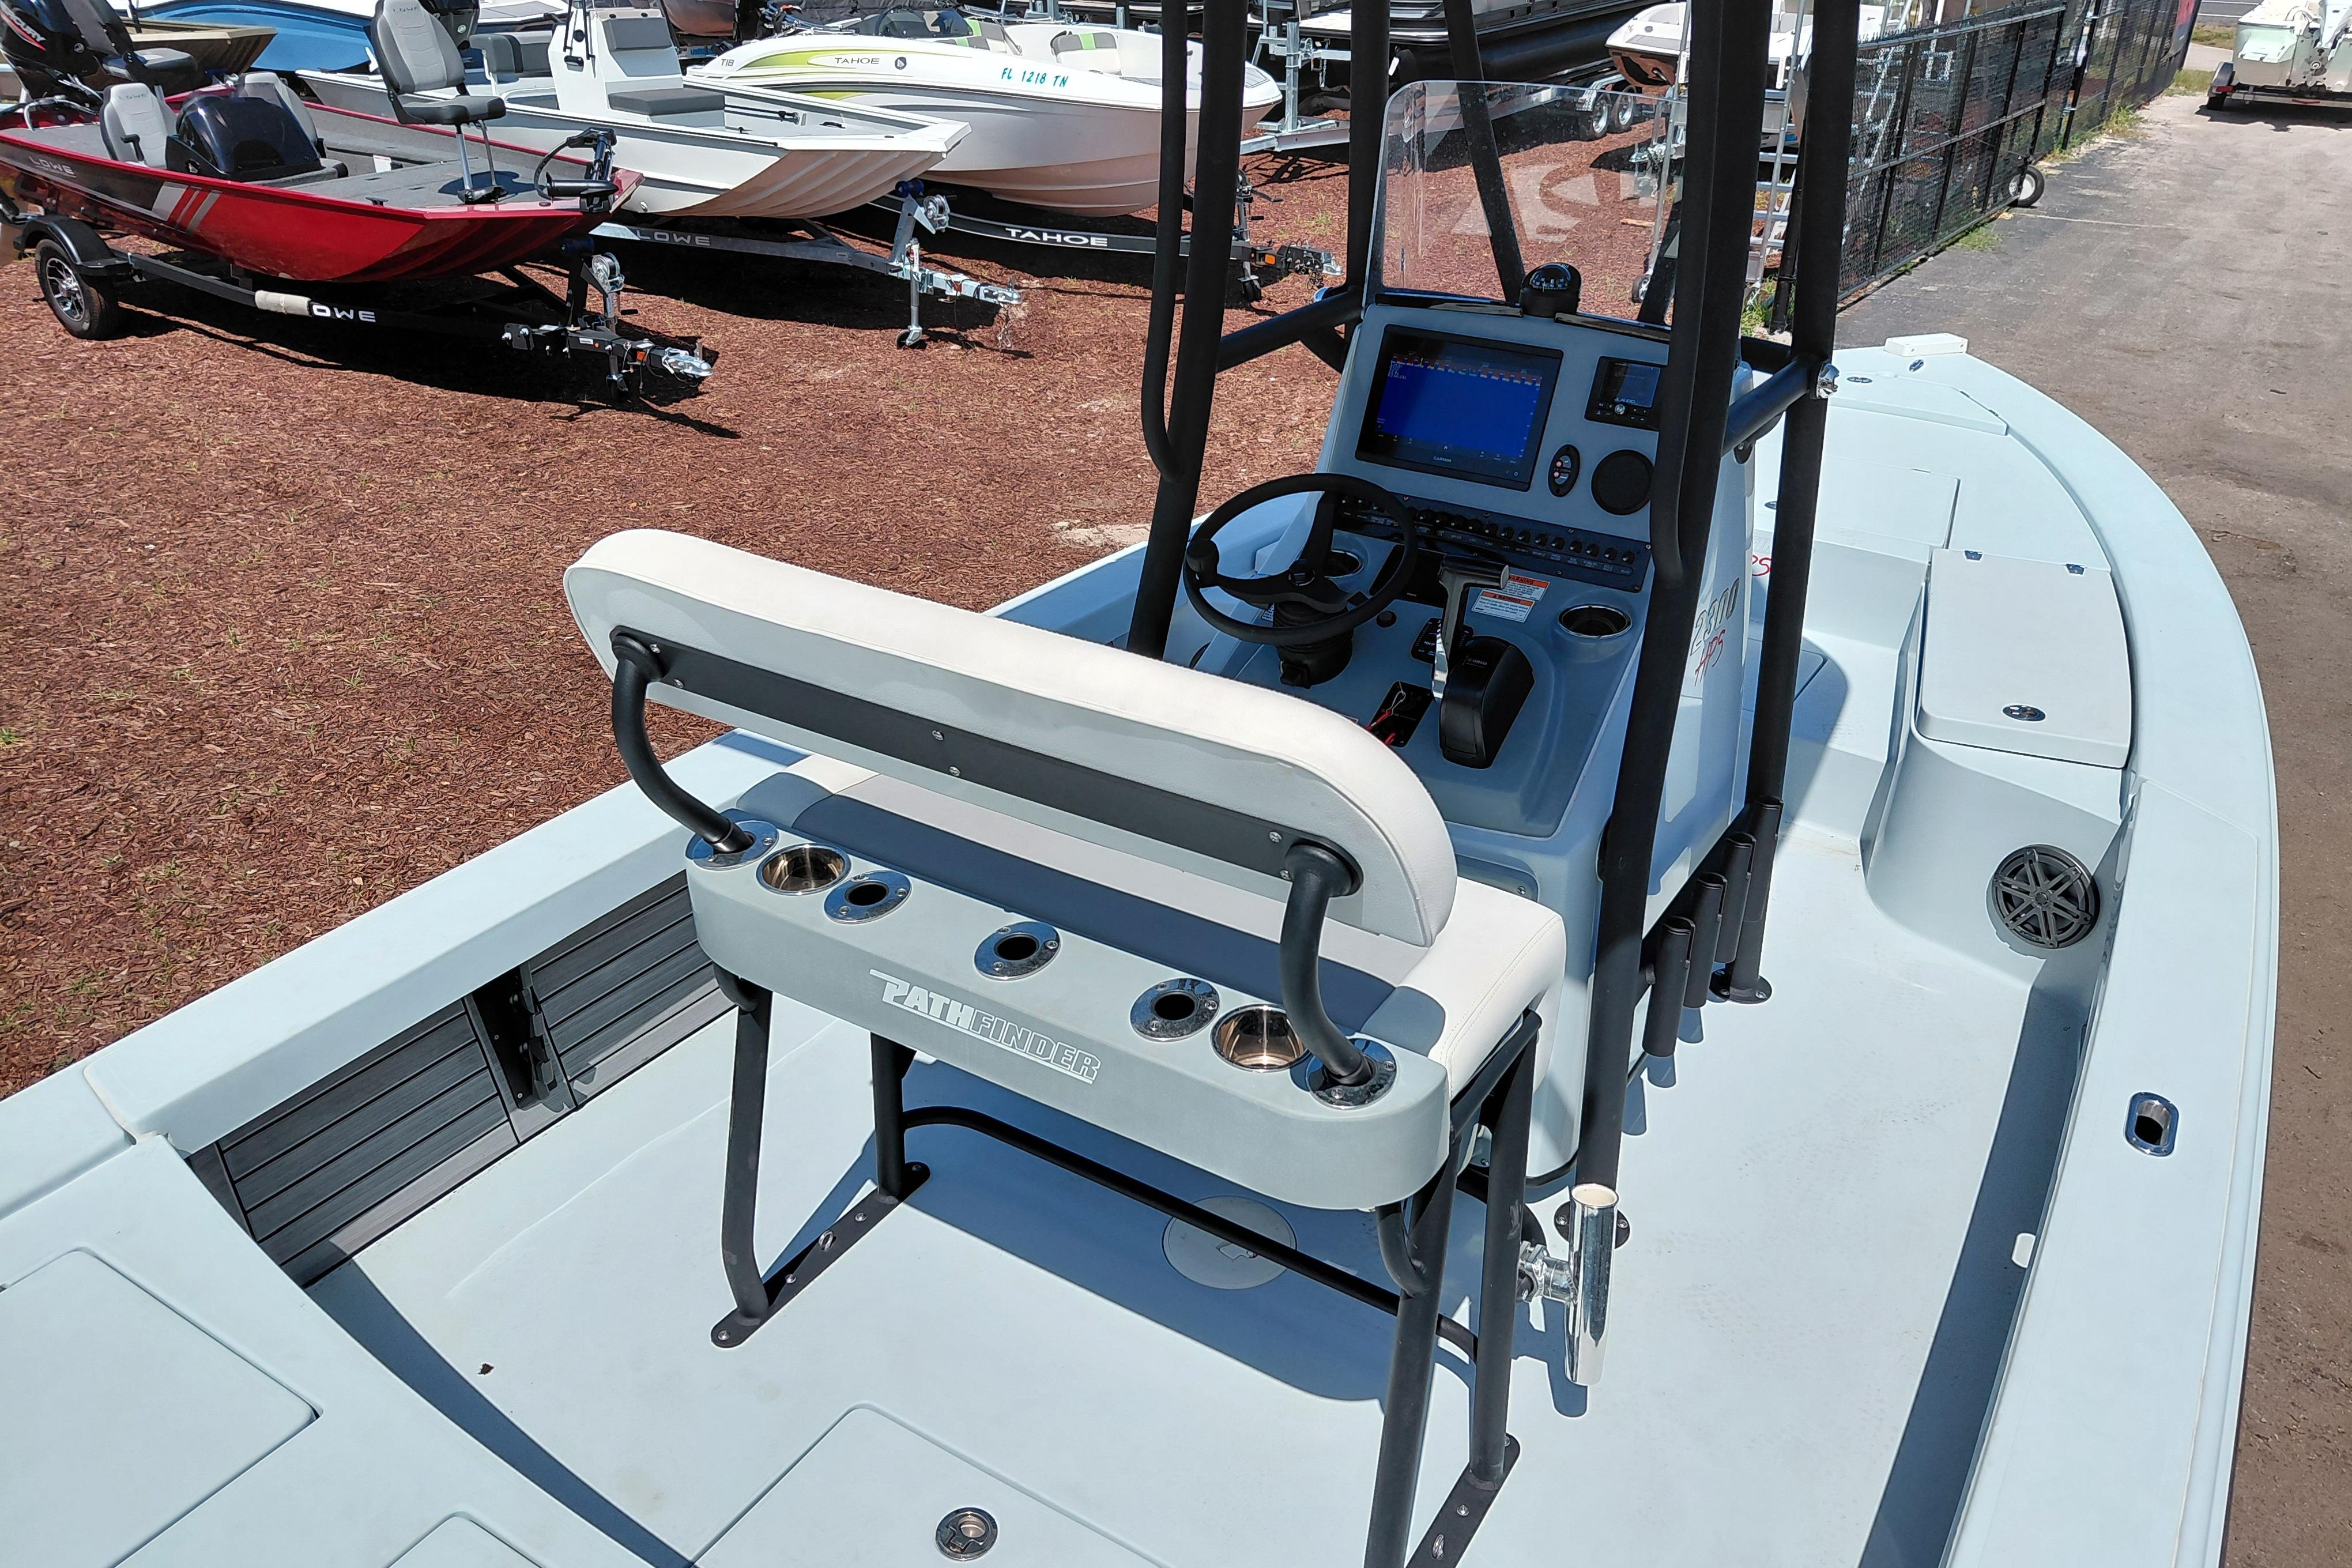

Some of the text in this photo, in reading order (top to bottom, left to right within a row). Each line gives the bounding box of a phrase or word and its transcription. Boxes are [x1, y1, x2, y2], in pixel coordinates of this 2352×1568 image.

[1001, 67, 1069, 88] FL 1218 TN
[29, 155, 74, 175] LOWE
[635, 229, 711, 247] LOWE
[1005, 227, 1109, 247] TAHOE
[312, 304, 376, 322] OWE
[1433, 455, 1452, 463] GARMIN
[1690, 577, 1740, 656] 2300
[1694, 629, 1726, 688] HPS
[869, 968, 1102, 1085] PATHFINDER
